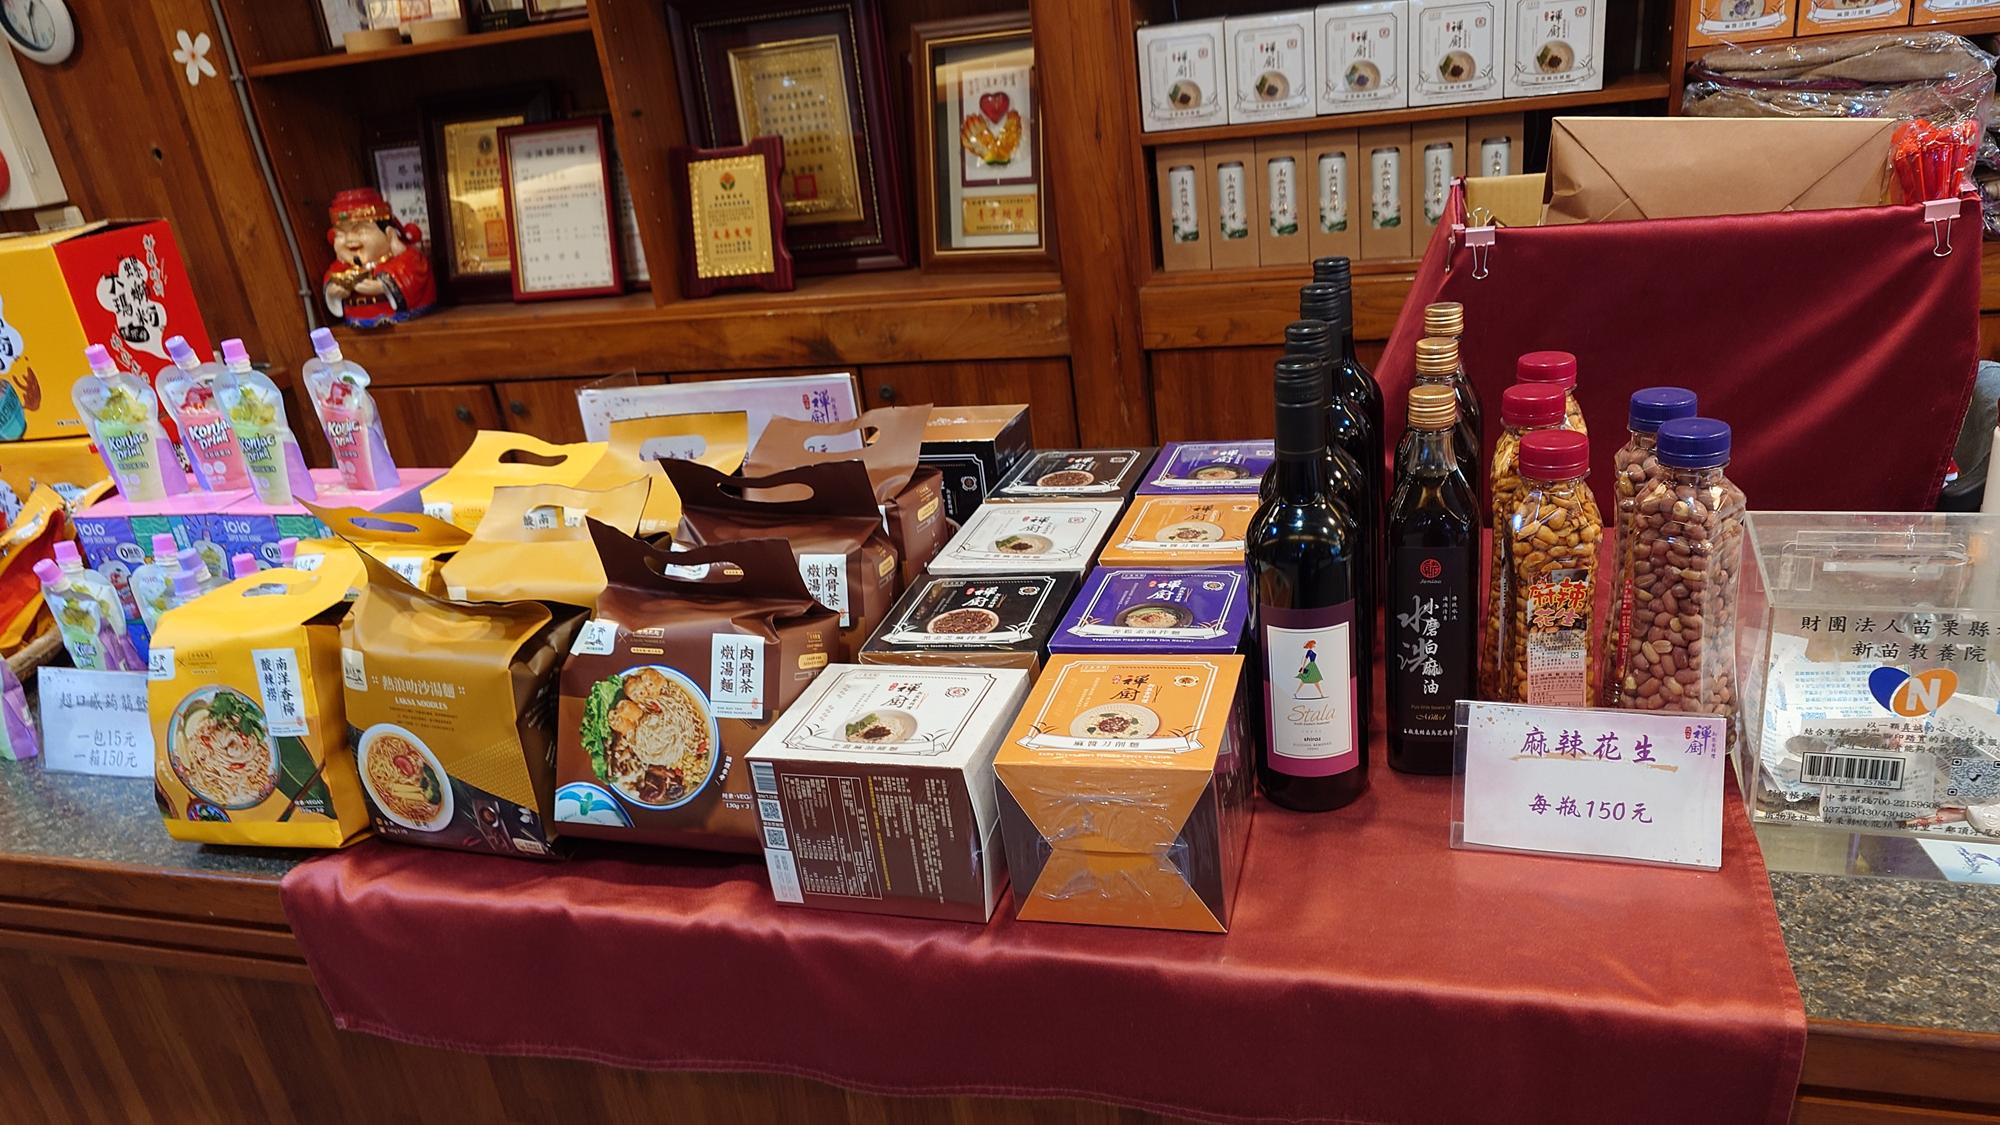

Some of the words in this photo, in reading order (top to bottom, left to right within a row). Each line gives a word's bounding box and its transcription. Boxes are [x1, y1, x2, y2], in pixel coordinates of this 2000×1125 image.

[825, 564, 840, 606] 肉骨茶
[1528, 577, 1586, 609] 麻辣
[1533, 608, 1582, 628] 花生
[1800, 615, 2000, 637] 財團法人苗栗縣
[1851, 641, 1987, 663] 新苗教養院
[720, 644, 735, 694] 燉湯麵
[738, 644, 755, 694] 肉骨茶
[275, 656, 297, 717] 南洋香檸
[1905, 678, 1941, 711] N
[1287, 704, 1336, 722] Stala
[77, 729, 137, 748] 一包15元
[1520, 727, 1657, 764] 麻辣花生
[73, 750, 138, 768] 一箱150元
[1528, 794, 1654, 825] 每瓶150元
